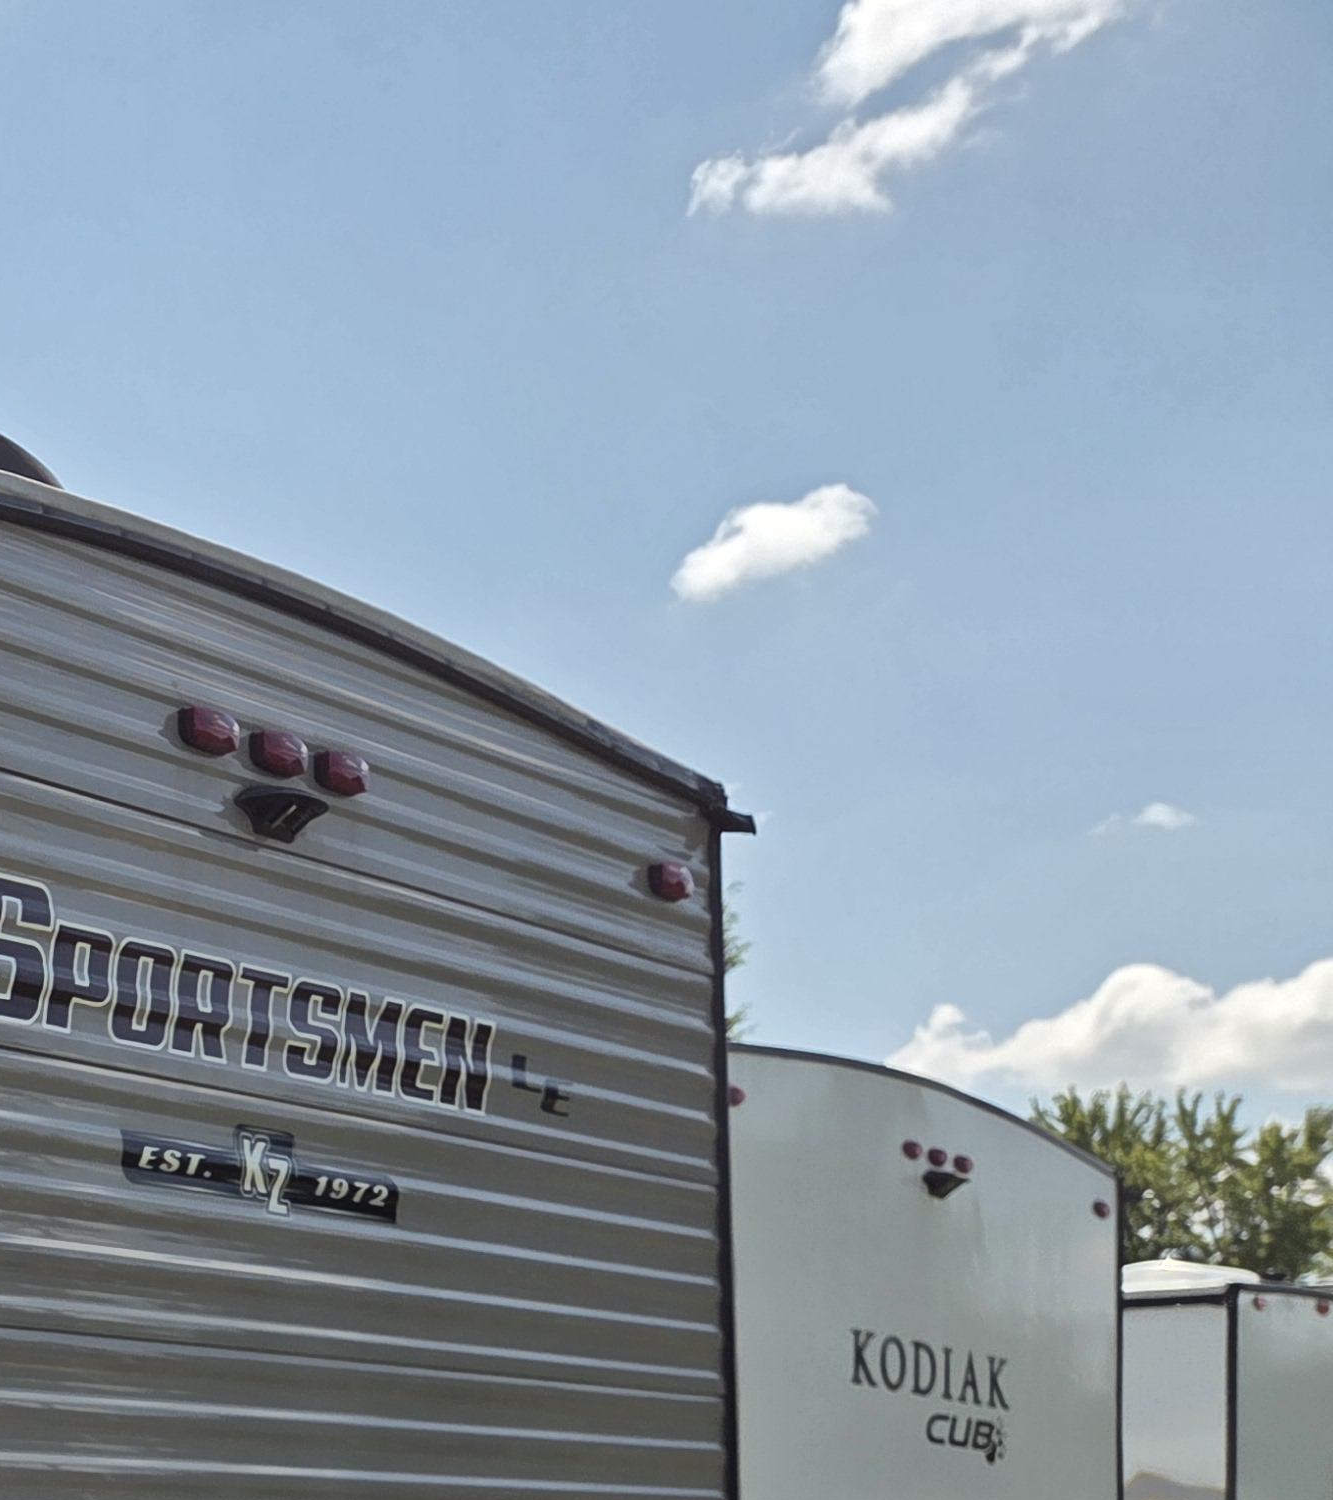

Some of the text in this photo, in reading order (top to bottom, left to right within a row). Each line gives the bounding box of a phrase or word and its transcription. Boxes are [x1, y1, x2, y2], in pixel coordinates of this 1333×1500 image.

[137, 1131, 389, 1217] EST. KZ 1972
[849, 1328, 1010, 1412] KODIAK
[925, 1413, 995, 1451] CUB
